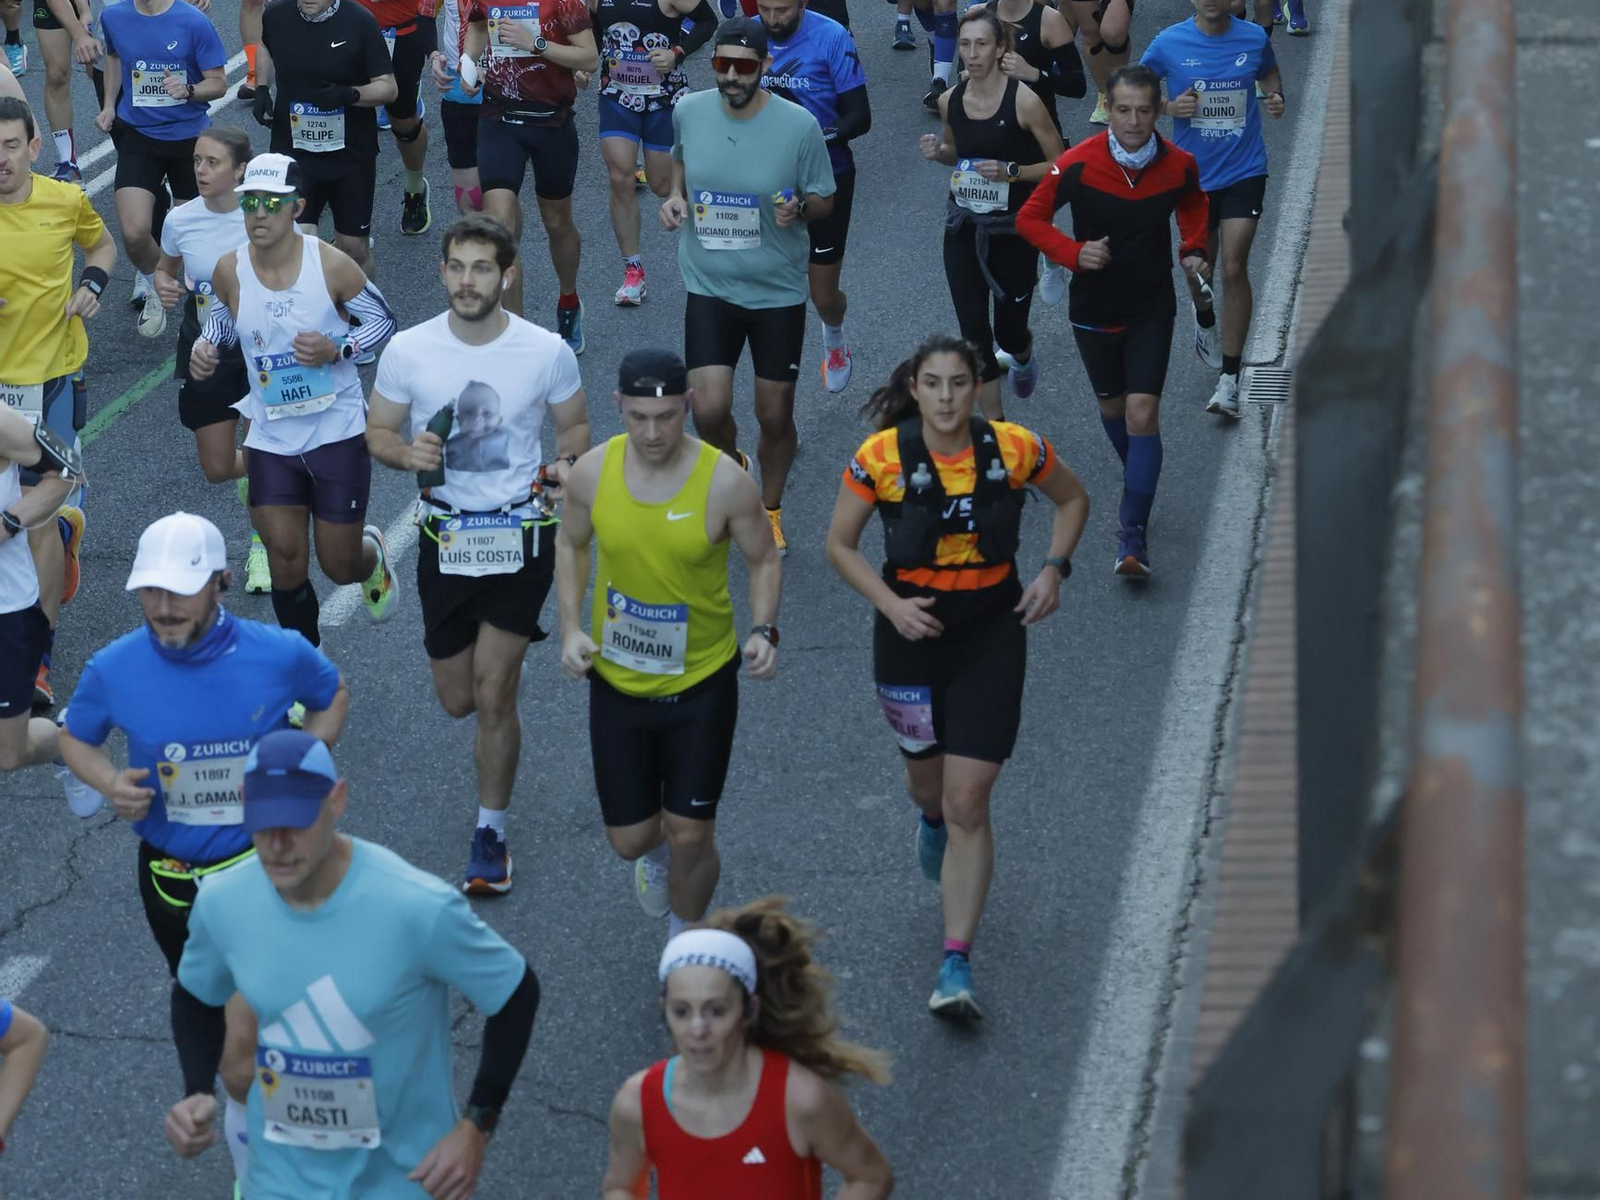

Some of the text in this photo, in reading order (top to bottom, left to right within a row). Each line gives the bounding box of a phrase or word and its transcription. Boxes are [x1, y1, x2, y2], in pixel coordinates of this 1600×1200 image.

[503, 8, 533, 21] ZURICH
[150, 62, 180, 71] ZURICH
[616, 71, 652, 85] MIGUEL
[1210, 81, 1241, 89] ZURICH
[1209, 96, 1230, 104] 11529
[1203, 106, 1236, 117] QUINO
[301, 130, 334, 141] FELIPE
[1201, 129, 1233, 138] SEVILLA
[248, 168, 280, 178] BANDIT
[958, 186, 999, 202] MIRIAM
[716, 195, 752, 205] ZURICH
[715, 211, 739, 221] 11028
[695, 227, 761, 238] LUCIANO ROCHA
[282, 374, 303, 385] 5586
[281, 386, 311, 402] HAFI
[466, 516, 512, 527] ZURICH
[475, 549, 522, 563] COSTA
[630, 603, 677, 620] ZURICH
[612, 631, 673, 658] ROMAIN
[192, 740, 250, 757] ZURICH
[193, 768, 231, 782] 11897
[287, 1103, 348, 1126] CASTI
